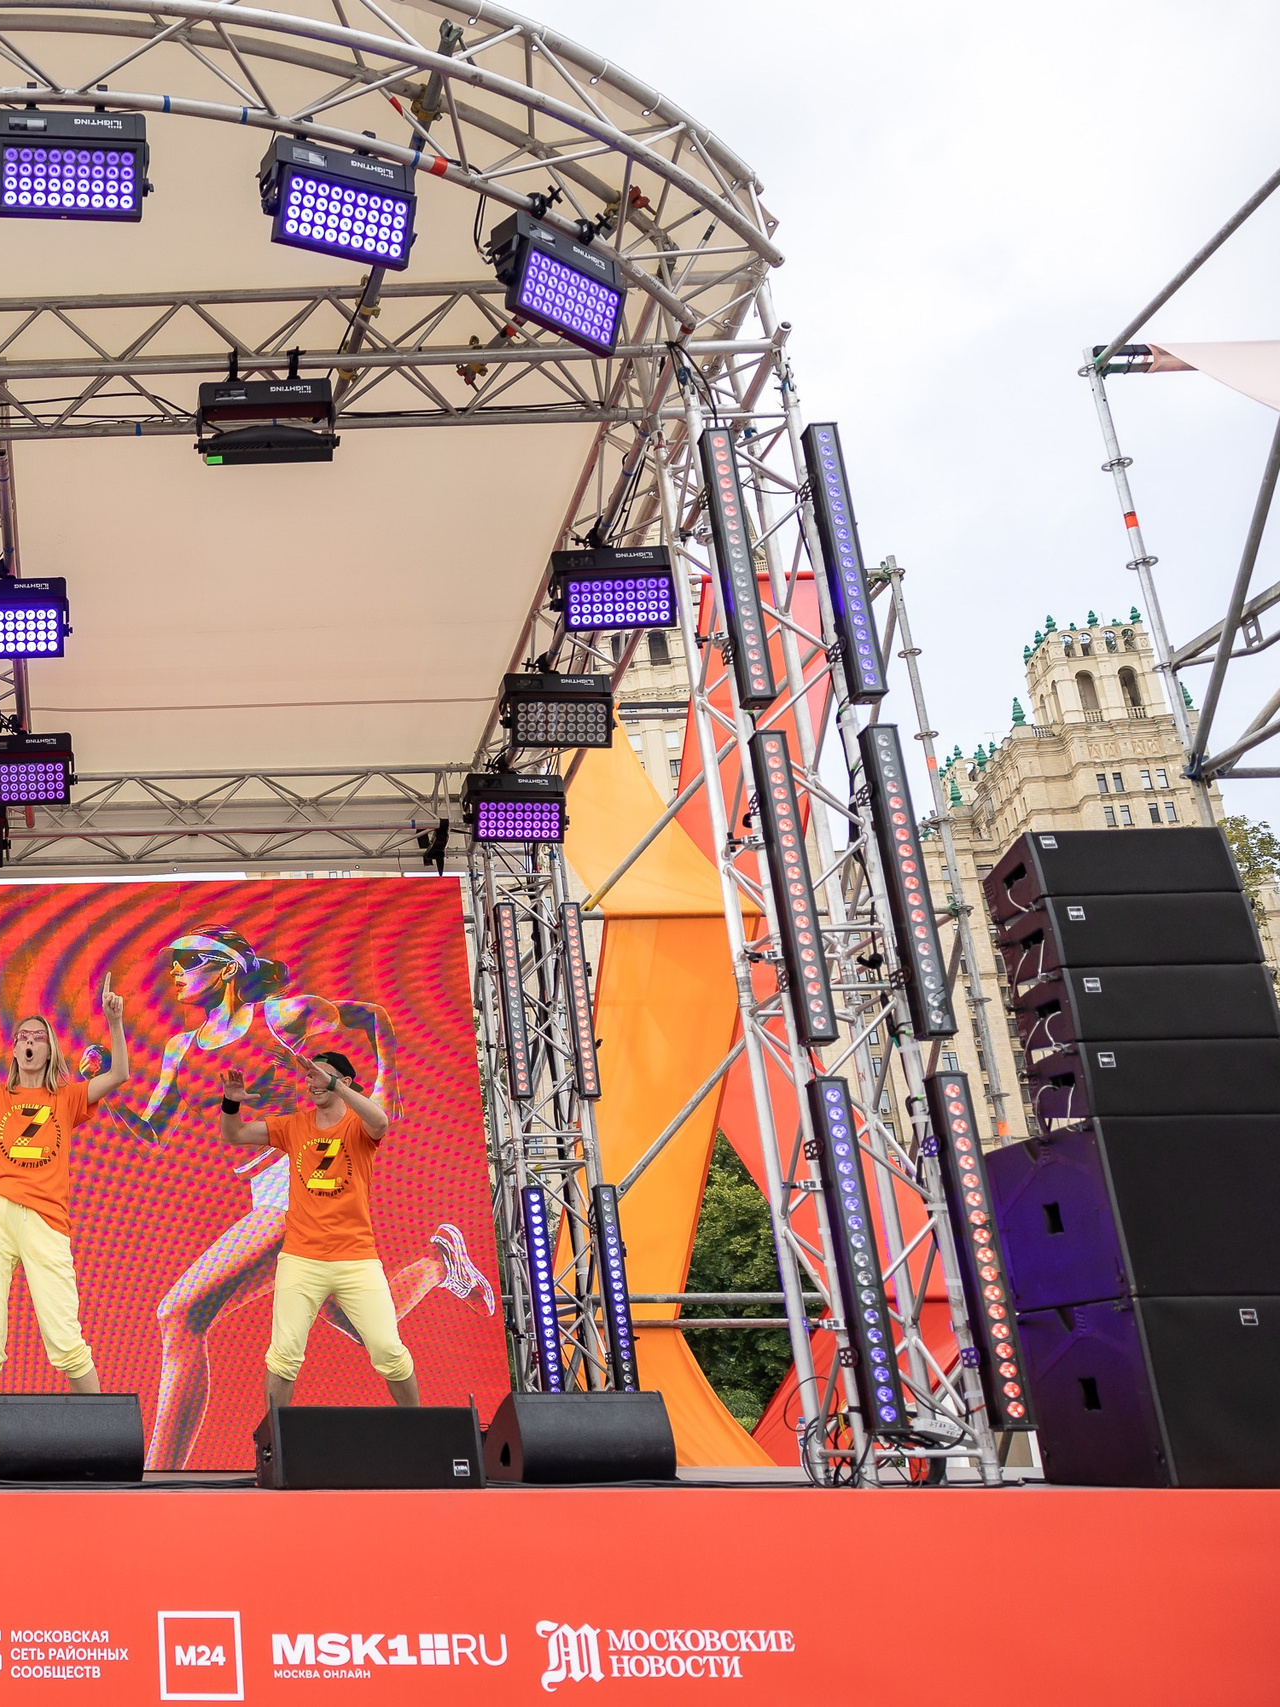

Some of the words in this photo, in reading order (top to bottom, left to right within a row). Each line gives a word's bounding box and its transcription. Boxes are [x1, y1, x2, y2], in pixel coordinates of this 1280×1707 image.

[10, 1630, 109, 1643] МОСКОВСКАЯ
[606, 1629, 796, 1652] МОСКОВСКИЕ
[10, 1648, 45, 1660] СЕТЬ
[48, 1645, 129, 1661] РАЙОННЫХ
[10, 1665, 101, 1680] СООБЩЕСТВ
[273, 1669, 321, 1679] МОСКВА
[323, 1668, 371, 1679] ОНЛАЙН
[608, 1655, 744, 1678] НОВОСТИ
